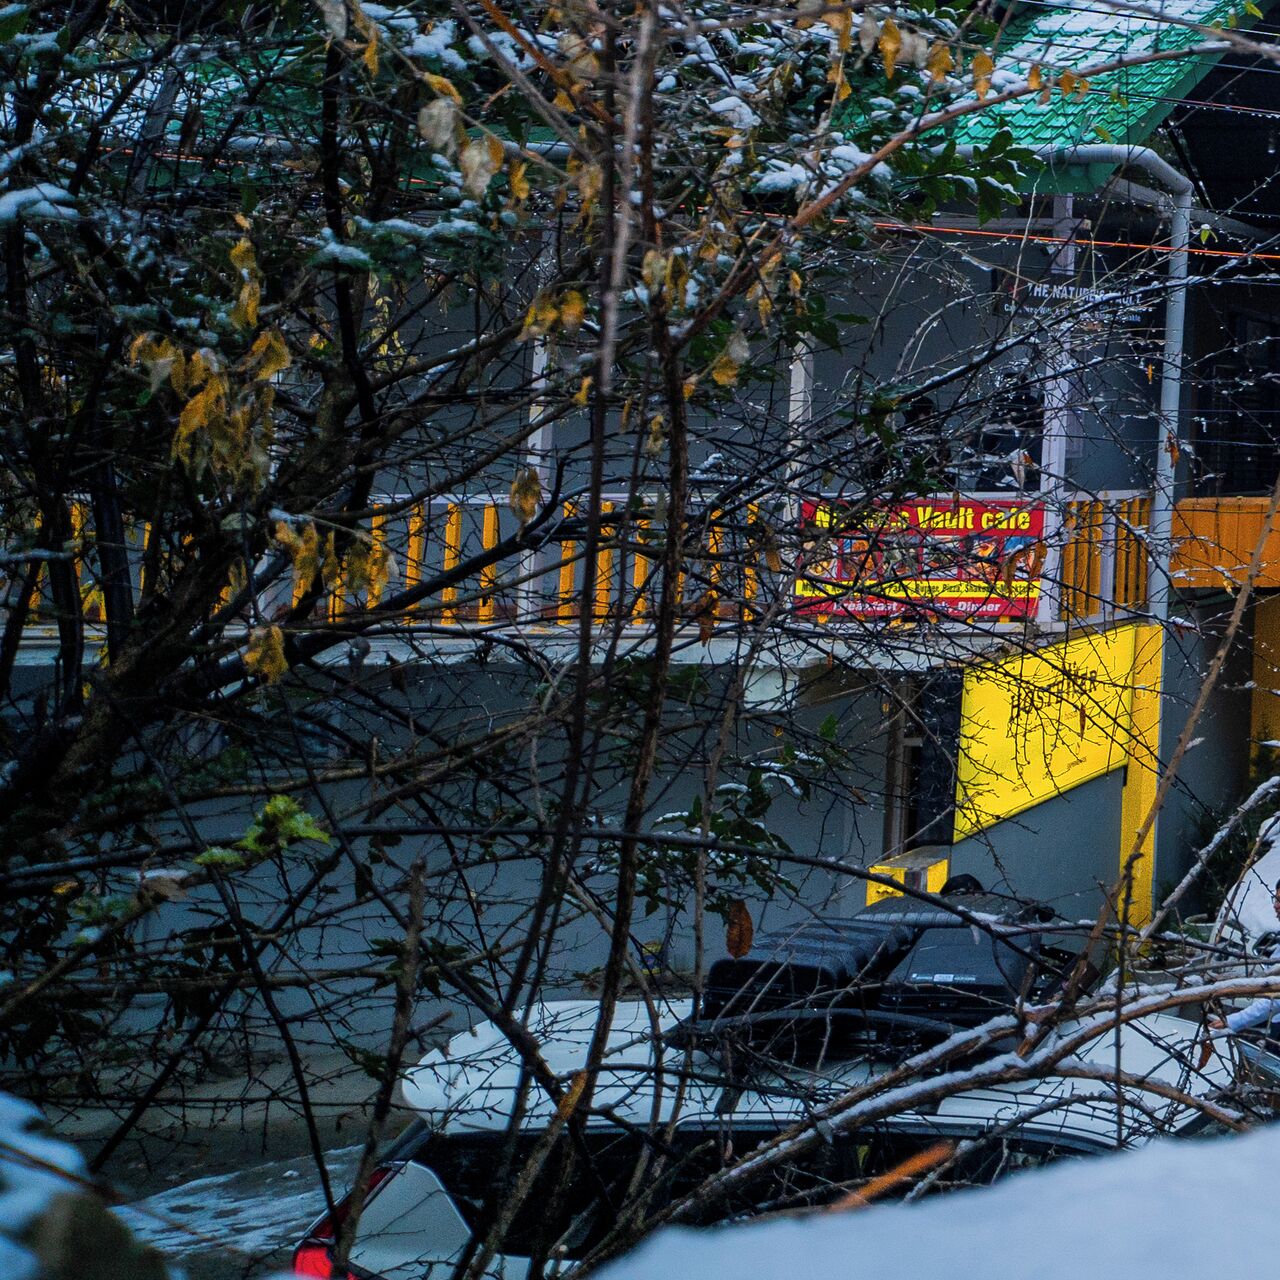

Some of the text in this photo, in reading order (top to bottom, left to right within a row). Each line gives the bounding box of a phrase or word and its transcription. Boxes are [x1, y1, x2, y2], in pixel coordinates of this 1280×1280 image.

[917, 506, 974, 529] Vault
[981, 507, 1031, 530] cafe
[957, 601, 1001, 612] Dinner
